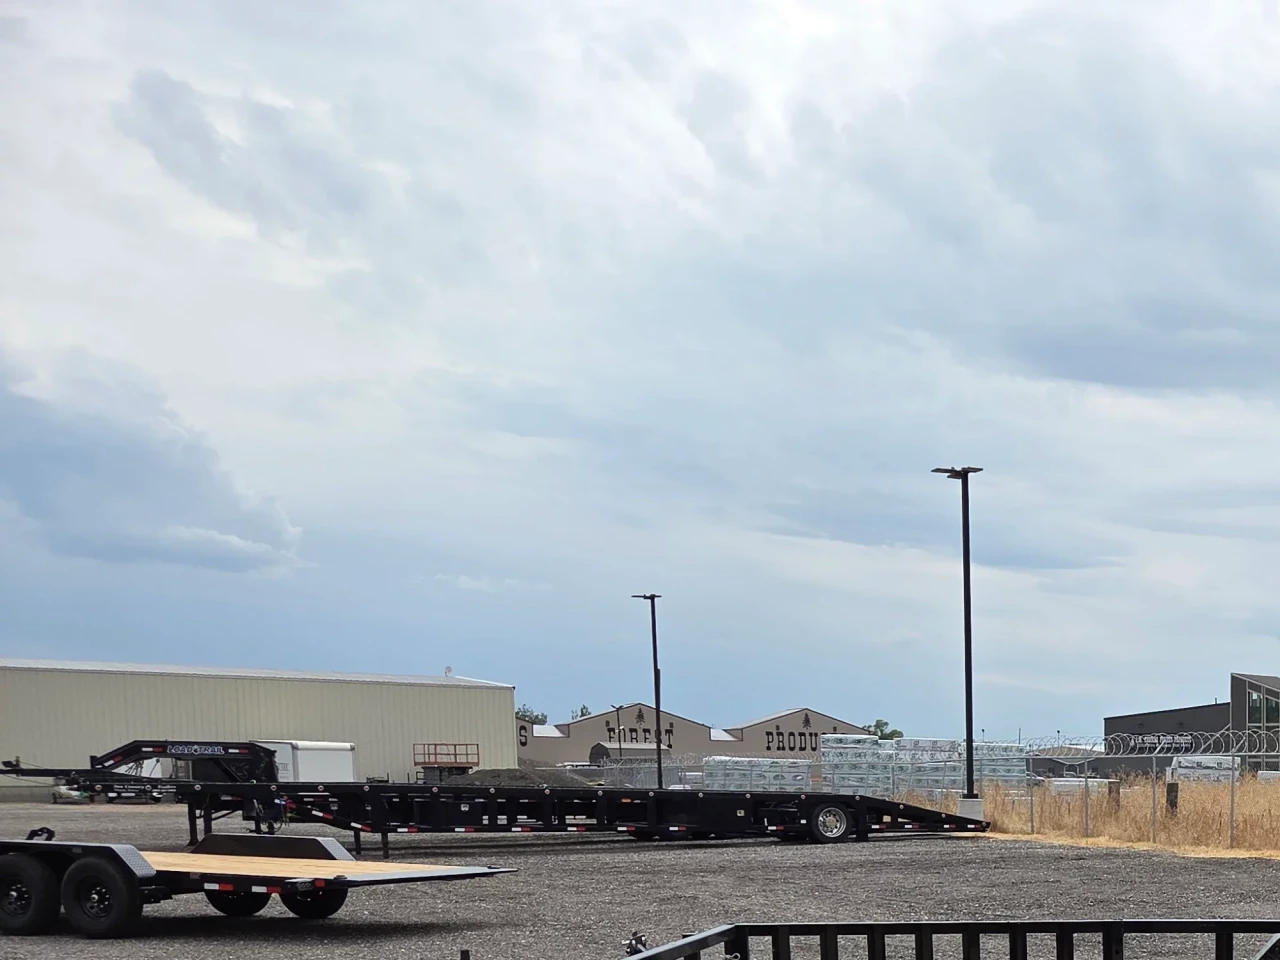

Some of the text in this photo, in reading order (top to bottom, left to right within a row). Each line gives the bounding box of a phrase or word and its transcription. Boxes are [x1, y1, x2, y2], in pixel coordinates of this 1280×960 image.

[519, 725, 528, 747] S
[765, 731, 846, 752] PRODU
[167, 745, 225, 755] LOAD TRAIL
